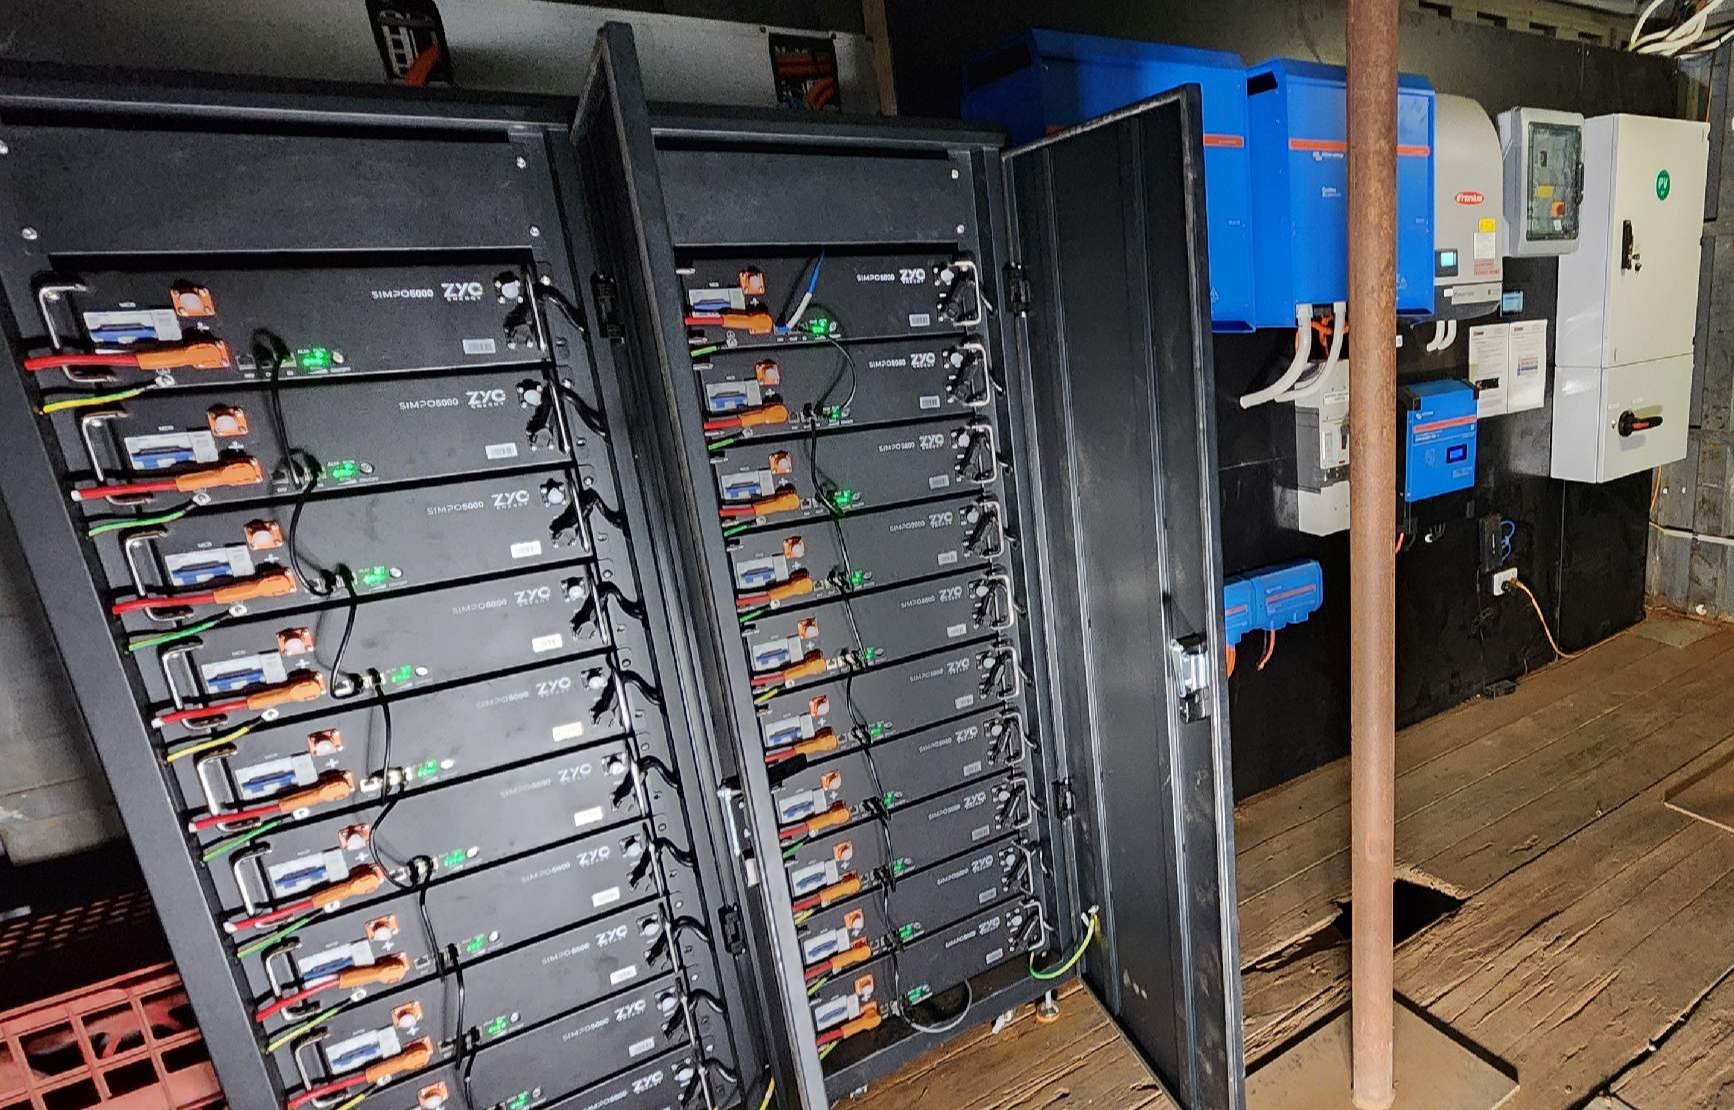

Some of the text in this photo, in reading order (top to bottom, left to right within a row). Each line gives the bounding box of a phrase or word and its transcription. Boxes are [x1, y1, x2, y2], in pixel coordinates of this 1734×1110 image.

[1658, 176, 1668, 190] PV
[371, 282, 483, 300] SIMPO5000 ZYC
[399, 389, 507, 411] SIMPO5000 ZYC
[426, 489, 530, 516] SIMPO5000 ZYC
